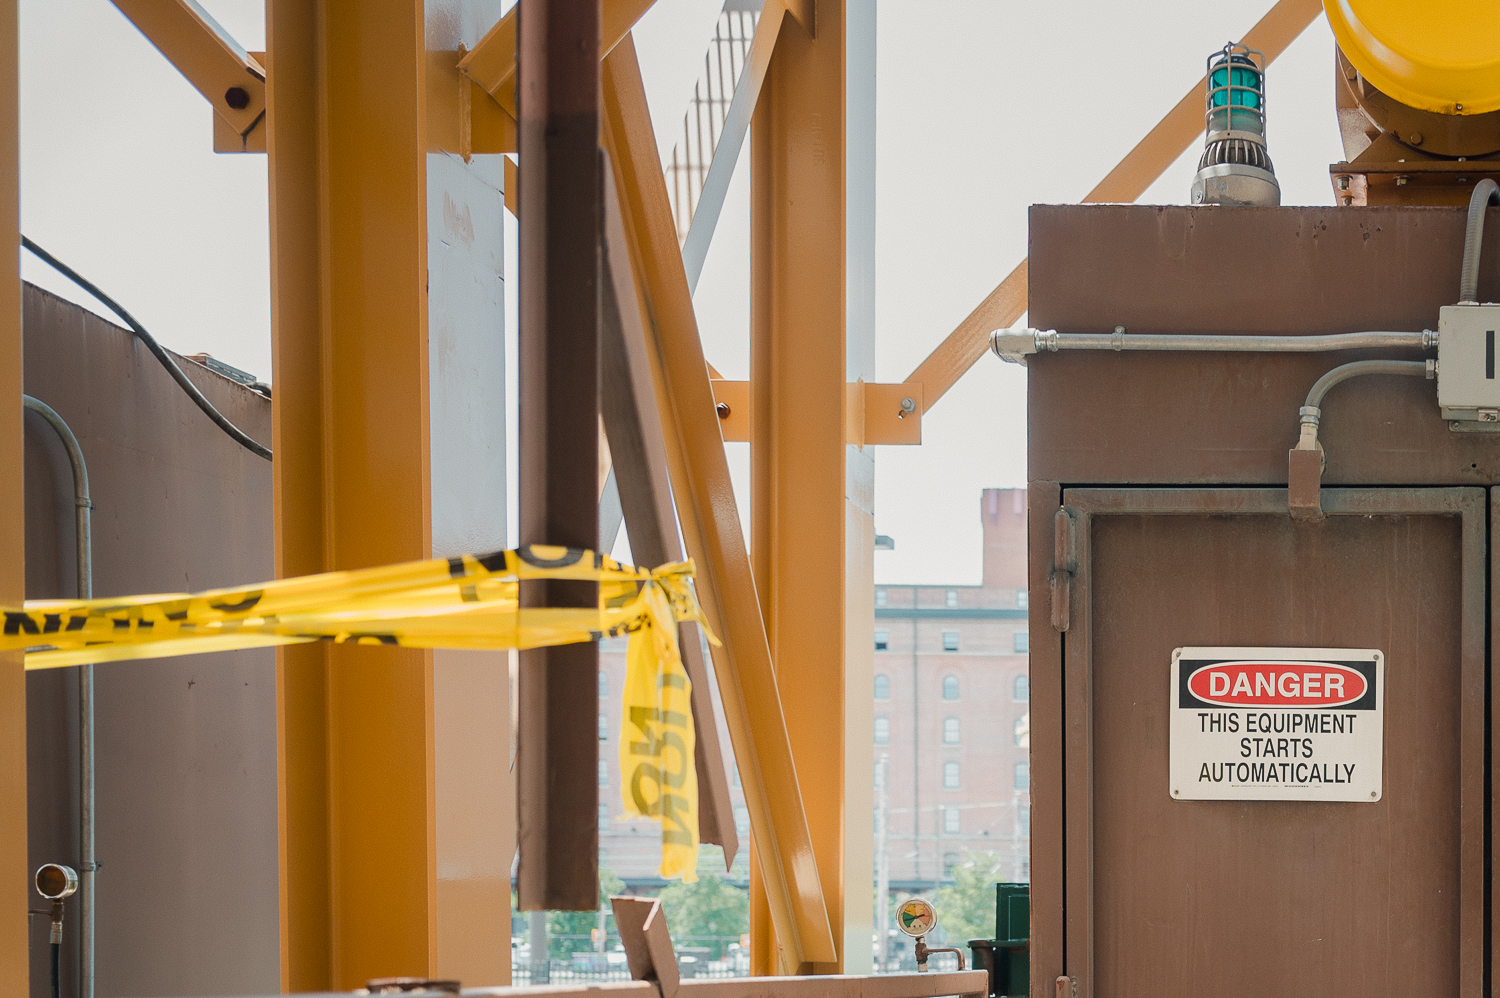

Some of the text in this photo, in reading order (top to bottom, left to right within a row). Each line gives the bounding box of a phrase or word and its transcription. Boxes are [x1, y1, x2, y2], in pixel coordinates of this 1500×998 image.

[1209, 672, 1345, 698] DANGER
[1197, 712, 1357, 734] THIS EQUIPMENT
[1240, 738, 1314, 759] STARTS
[1198, 762, 1356, 784] AUTOMATICALLY
